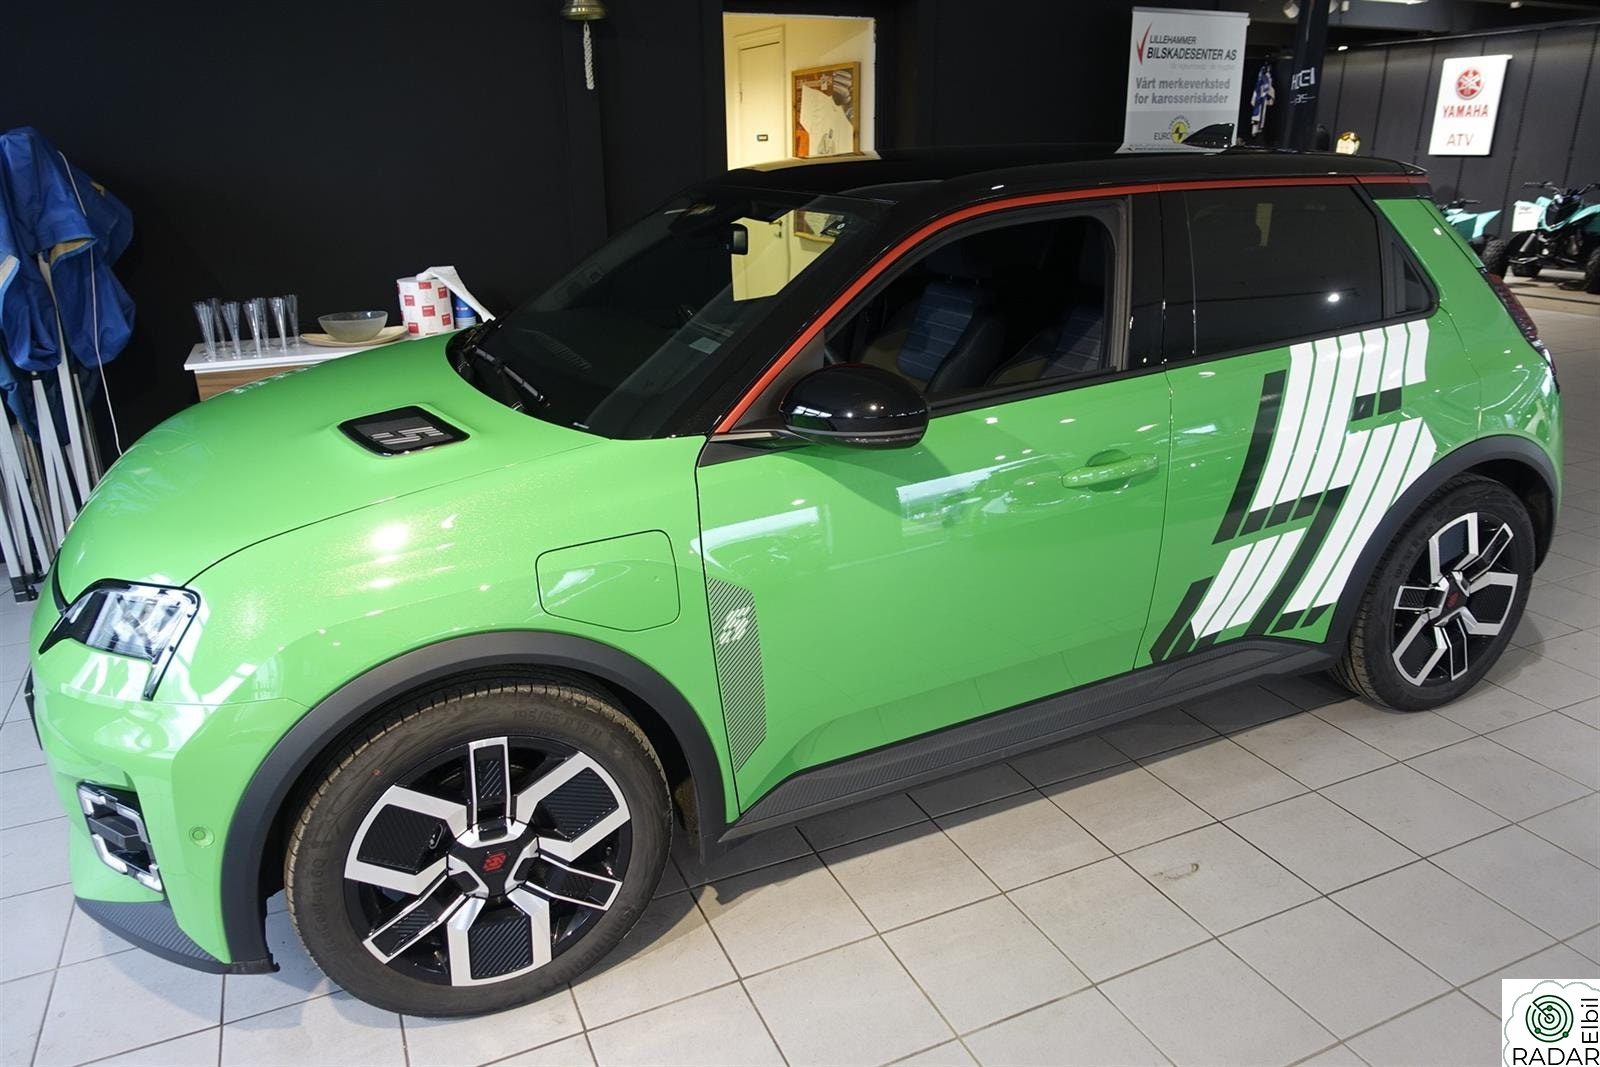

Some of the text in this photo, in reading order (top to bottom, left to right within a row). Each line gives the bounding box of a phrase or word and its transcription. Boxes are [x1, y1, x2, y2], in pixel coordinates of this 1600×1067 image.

[1149, 35, 1197, 45] LILLEHAMMER
[1146, 47, 1238, 61] BILSKADESENTER AS
[1135, 76, 1231, 90] Vårt merkeverksted
[1134, 92, 1228, 104] for karosseriskader
[1442, 104, 1489, 118] YAMAHA
[1446, 133, 1474, 146] ATV
